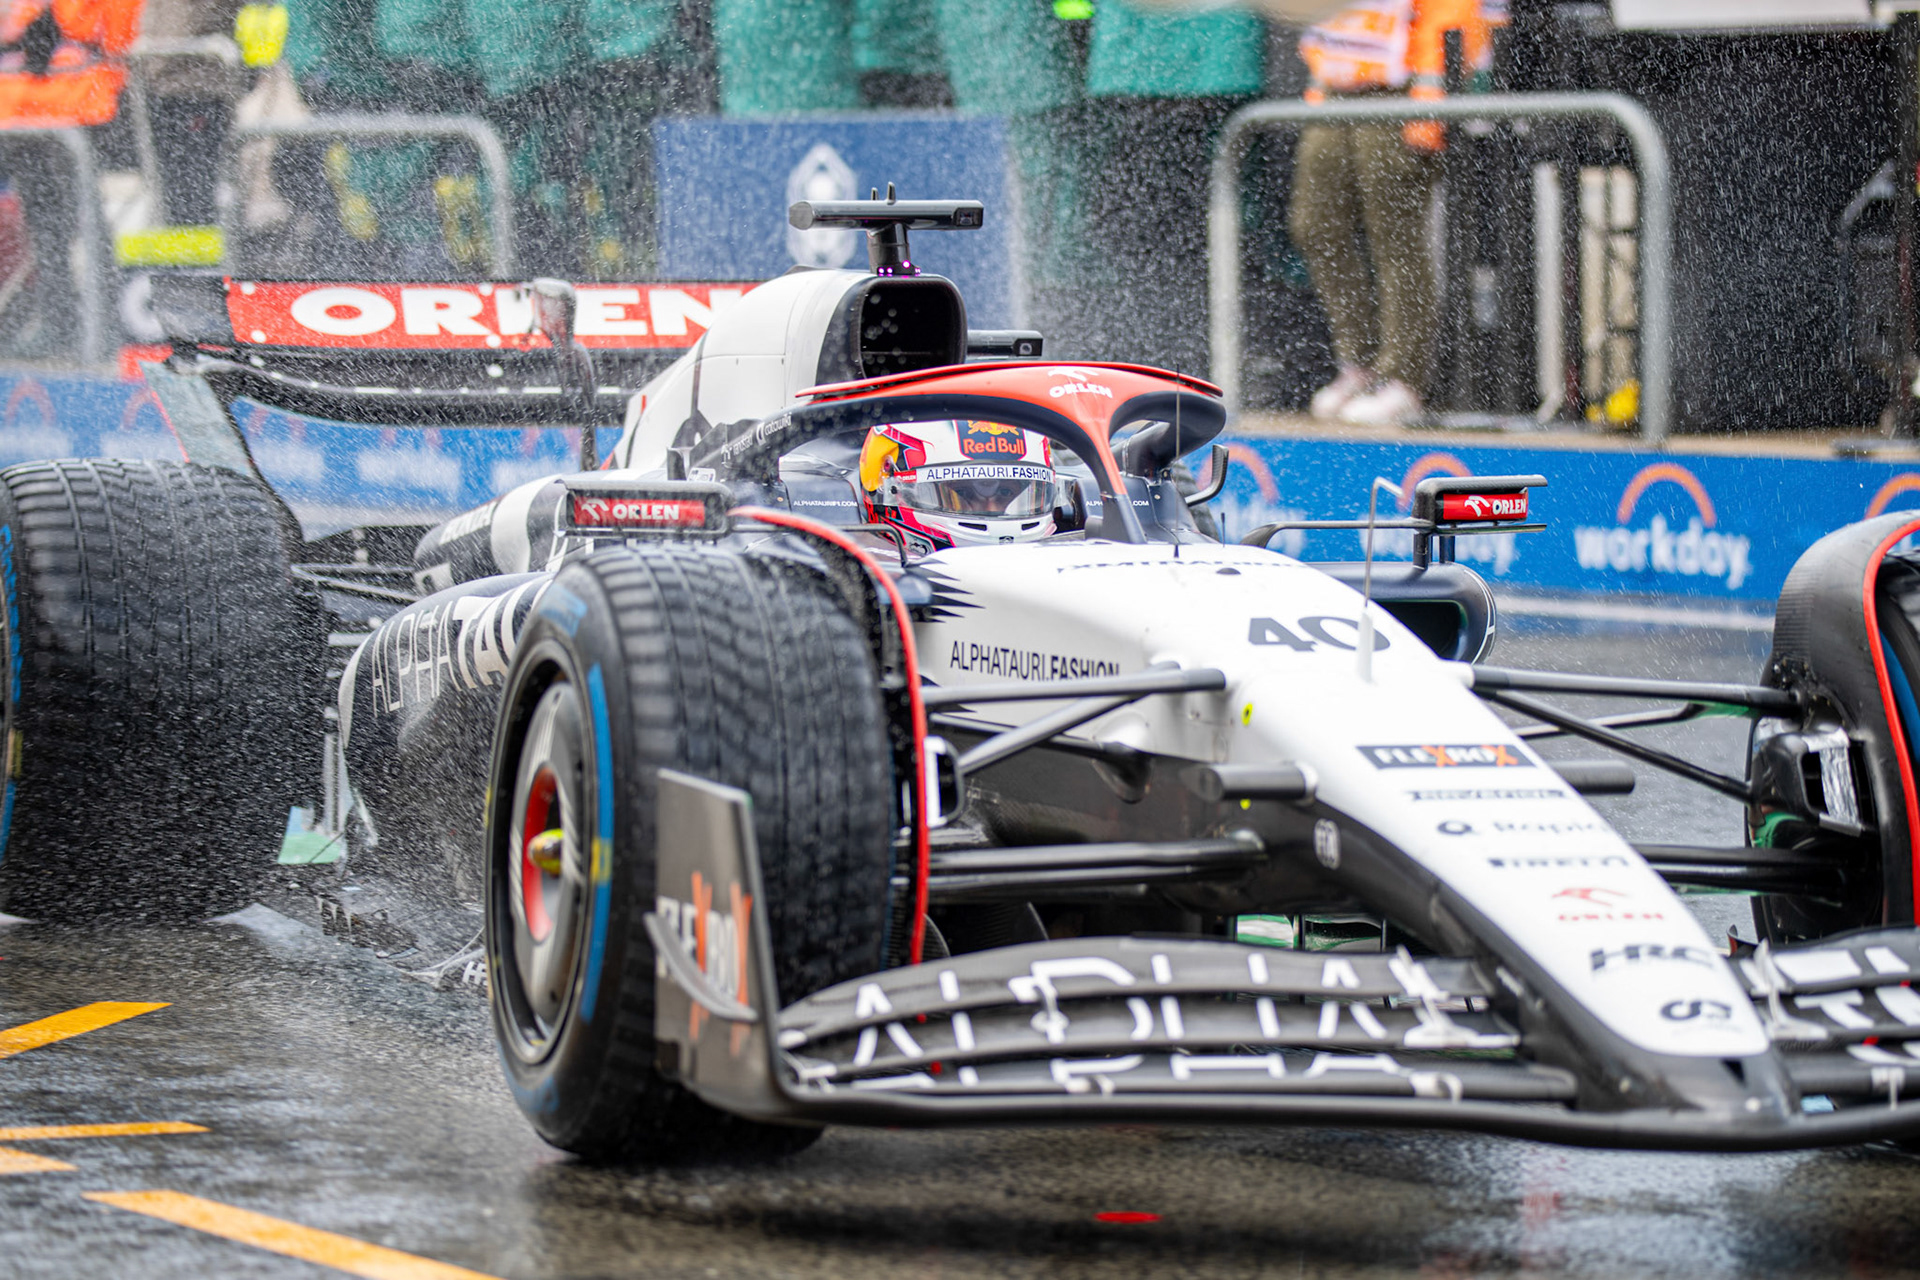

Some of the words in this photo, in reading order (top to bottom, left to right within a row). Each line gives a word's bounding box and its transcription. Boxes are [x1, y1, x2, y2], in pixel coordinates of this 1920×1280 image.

[1049, 383, 1113, 399] ORLEN
[963, 437, 996, 455] Red
[997, 436, 1026, 456] Bull
[926, 465, 1052, 482] ALPHATAURI.FASHION
[612, 503, 680, 520] ORLEN
[1492, 498, 1527, 516] ORLEN
[1573, 512, 1754, 591] workday
[1247, 615, 1391, 652] 40
[950, 640, 1120, 682] ALPHATAURI.FASHION
[1590, 943, 1714, 972] HRC
